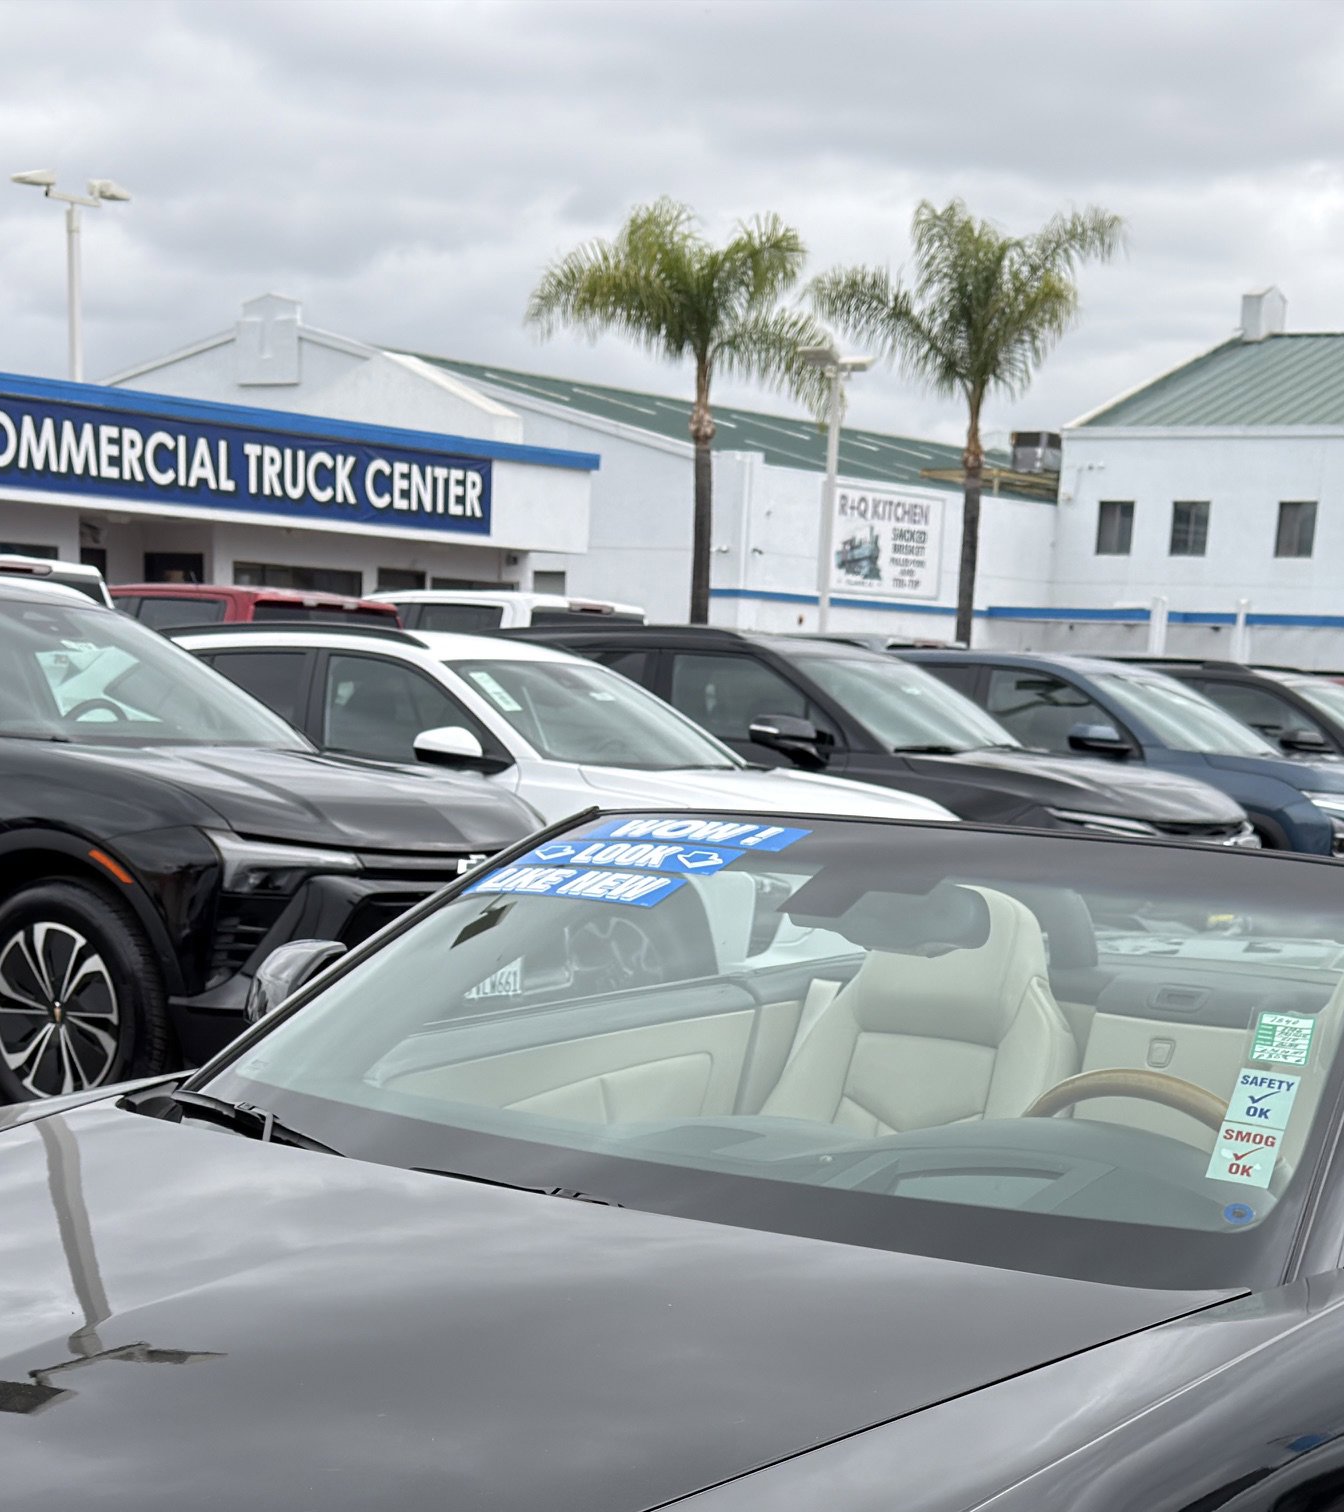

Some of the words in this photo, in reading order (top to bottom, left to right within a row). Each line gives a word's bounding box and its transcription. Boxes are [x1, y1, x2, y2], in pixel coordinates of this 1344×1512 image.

[243, 443, 357, 505] TRUCK
[364, 458, 483, 518] CENTER
[871, 499, 931, 526] KITCHEN
[570, 843, 685, 868] LOOK
[477, 867, 578, 893] LIKE
[556, 871, 672, 902] NEW
[1241, 1075, 1295, 1092] SAFETY
[1246, 1106, 1272, 1119] OK
[1223, 1129, 1276, 1147] SMOG
[1228, 1163, 1254, 1177] OK
